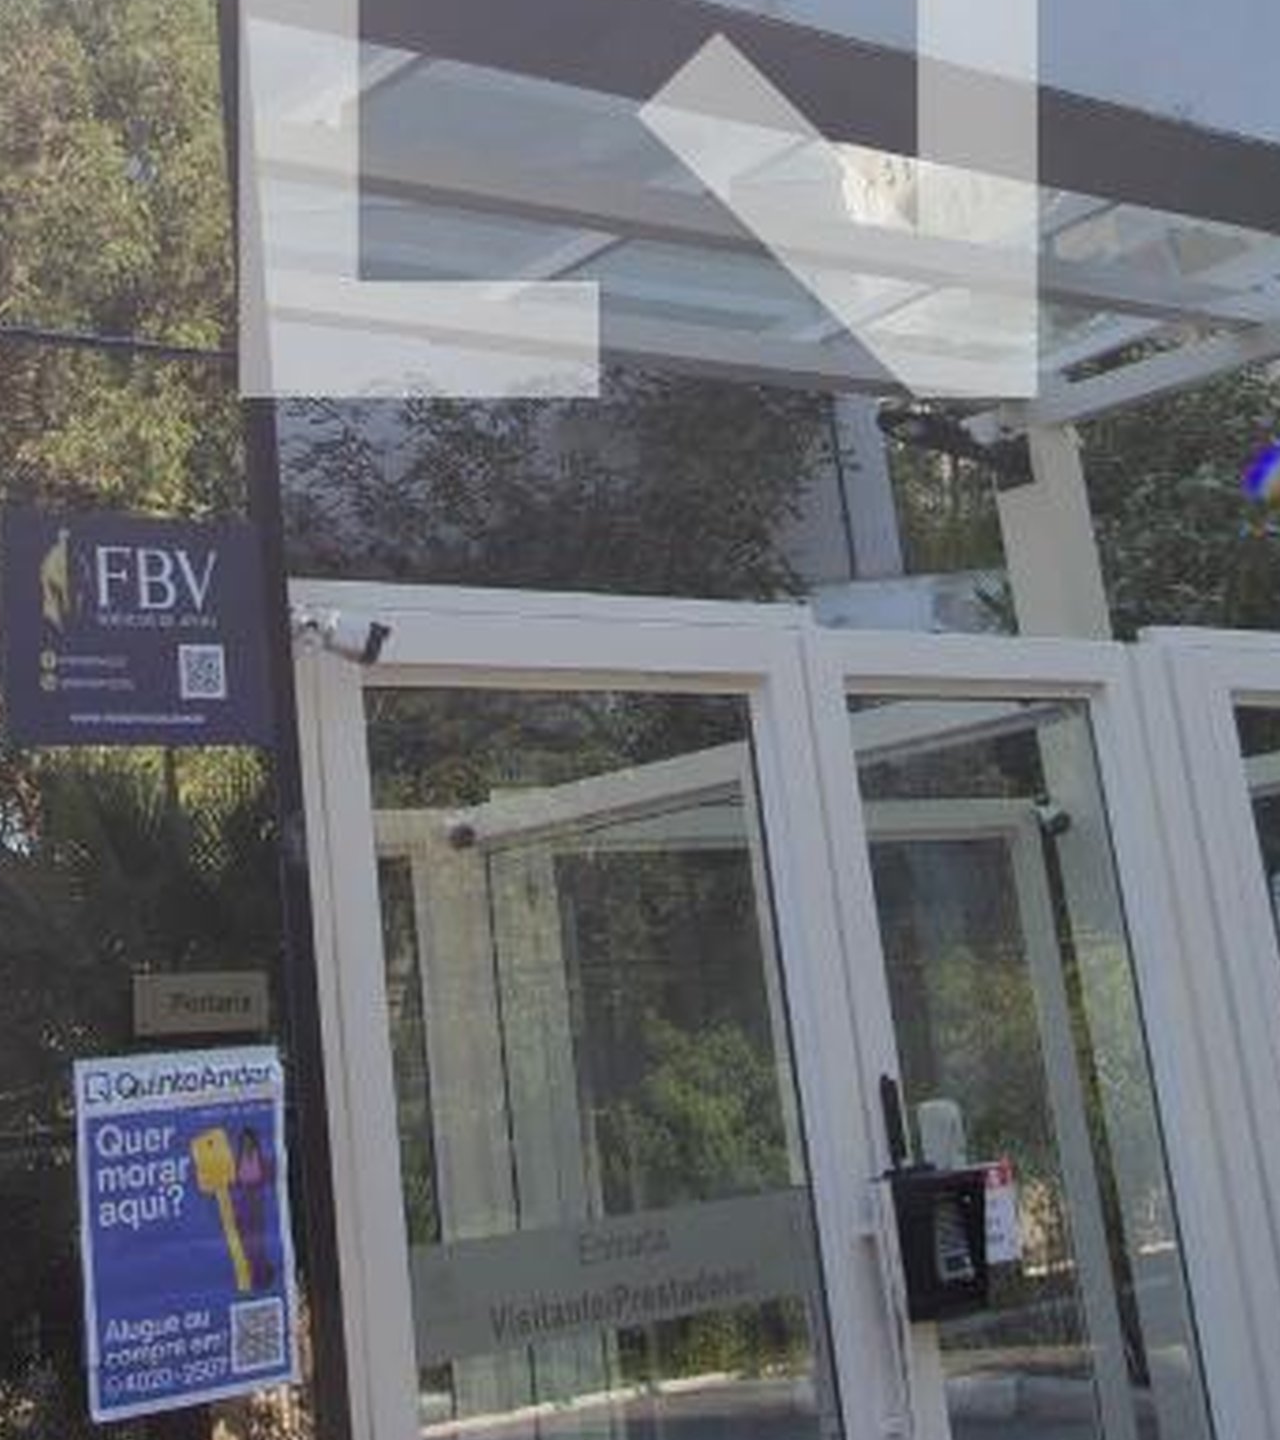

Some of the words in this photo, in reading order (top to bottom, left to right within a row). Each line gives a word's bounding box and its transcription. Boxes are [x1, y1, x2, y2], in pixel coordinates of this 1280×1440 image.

[96, 545, 217, 612] FBV
[116, 1063, 274, 1100] QuintoAndar
[96, 1124, 175, 1157] Quer
[98, 1157, 190, 1194] morar
[99, 1184, 184, 1230] aqui?
